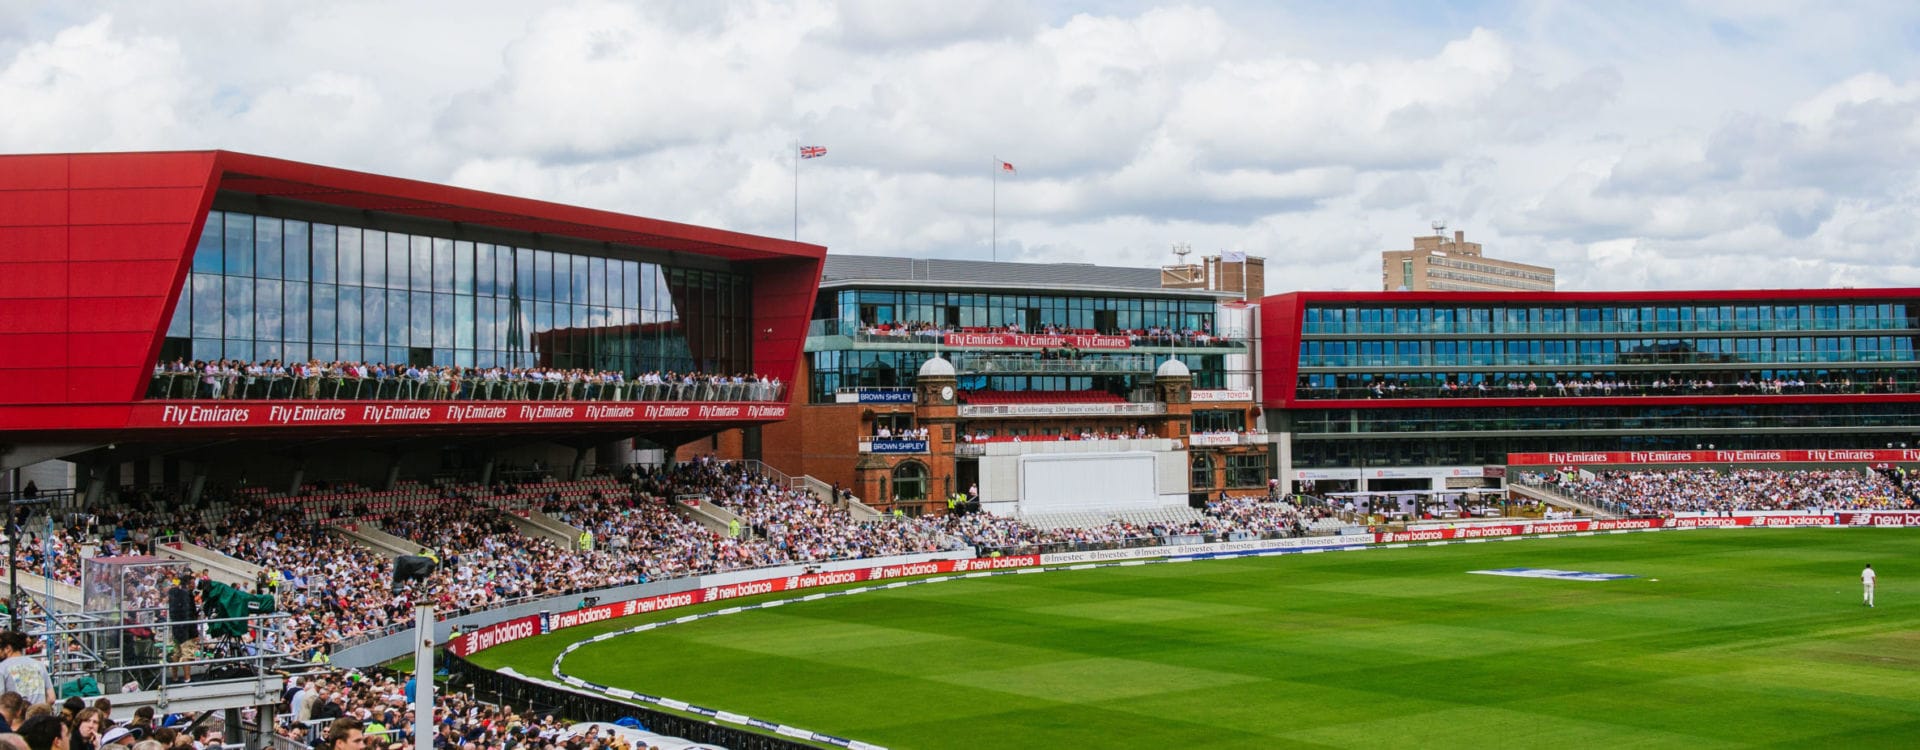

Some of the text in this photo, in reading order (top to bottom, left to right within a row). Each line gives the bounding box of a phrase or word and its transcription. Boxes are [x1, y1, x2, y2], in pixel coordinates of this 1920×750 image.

[950, 334, 1004, 346] Fly Emirates
[1015, 335, 1066, 346] Fly Emirates
[1077, 336, 1126, 348] Fly Emirates
[162, 405, 250, 425] Fly Emirates
[270, 405, 346, 424] Fly Emirates
[363, 405, 431, 423] Fly Emirates
[447, 405, 507, 422] Fly Emirates
[520, 405, 574, 421] Fly Emirates
[585, 405, 634, 420] Fly Emirates
[645, 405, 689, 420] Fly Emirates
[699, 405, 739, 420] Fly Emirates
[748, 405, 785, 419] Fly Emirates
[1550, 453, 1607, 464] Fly Emirates
[1631, 452, 1691, 463] Fly Emirates
[1717, 451, 1781, 462] Fly Emirates
[1808, 450, 1875, 461] Fly Emirates
[1903, 450, 1920, 461] Fly
[1600, 522, 1616, 530] new
[1617, 520, 1650, 528] balance
[1698, 518, 1736, 526] balance
[1789, 516, 1830, 525] balance
[1874, 516, 1903, 525] new
[1466, 529, 1481, 537] new
[1482, 527, 1512, 536] balance
[1550, 523, 1577, 532] balance
[1412, 531, 1442, 540] balance
[1052, 554, 1084, 562] Investec
[1097, 551, 1128, 559] Investec
[1141, 548, 1171, 556] Investec
[971, 559, 991, 570] new
[993, 556, 1034, 568] balance
[884, 567, 901, 577] new
[902, 563, 938, 576] balance
[800, 577, 817, 588] new
[819, 572, 855, 585] balance
[720, 586, 736, 599] new
[738, 582, 772, 595] balance
[638, 600, 655, 613] new
[657, 594, 691, 609] balance
[560, 614, 577, 628] new
[579, 608, 611, 624] balance
[480, 631, 494, 650] new
[495, 621, 533, 644] balance
